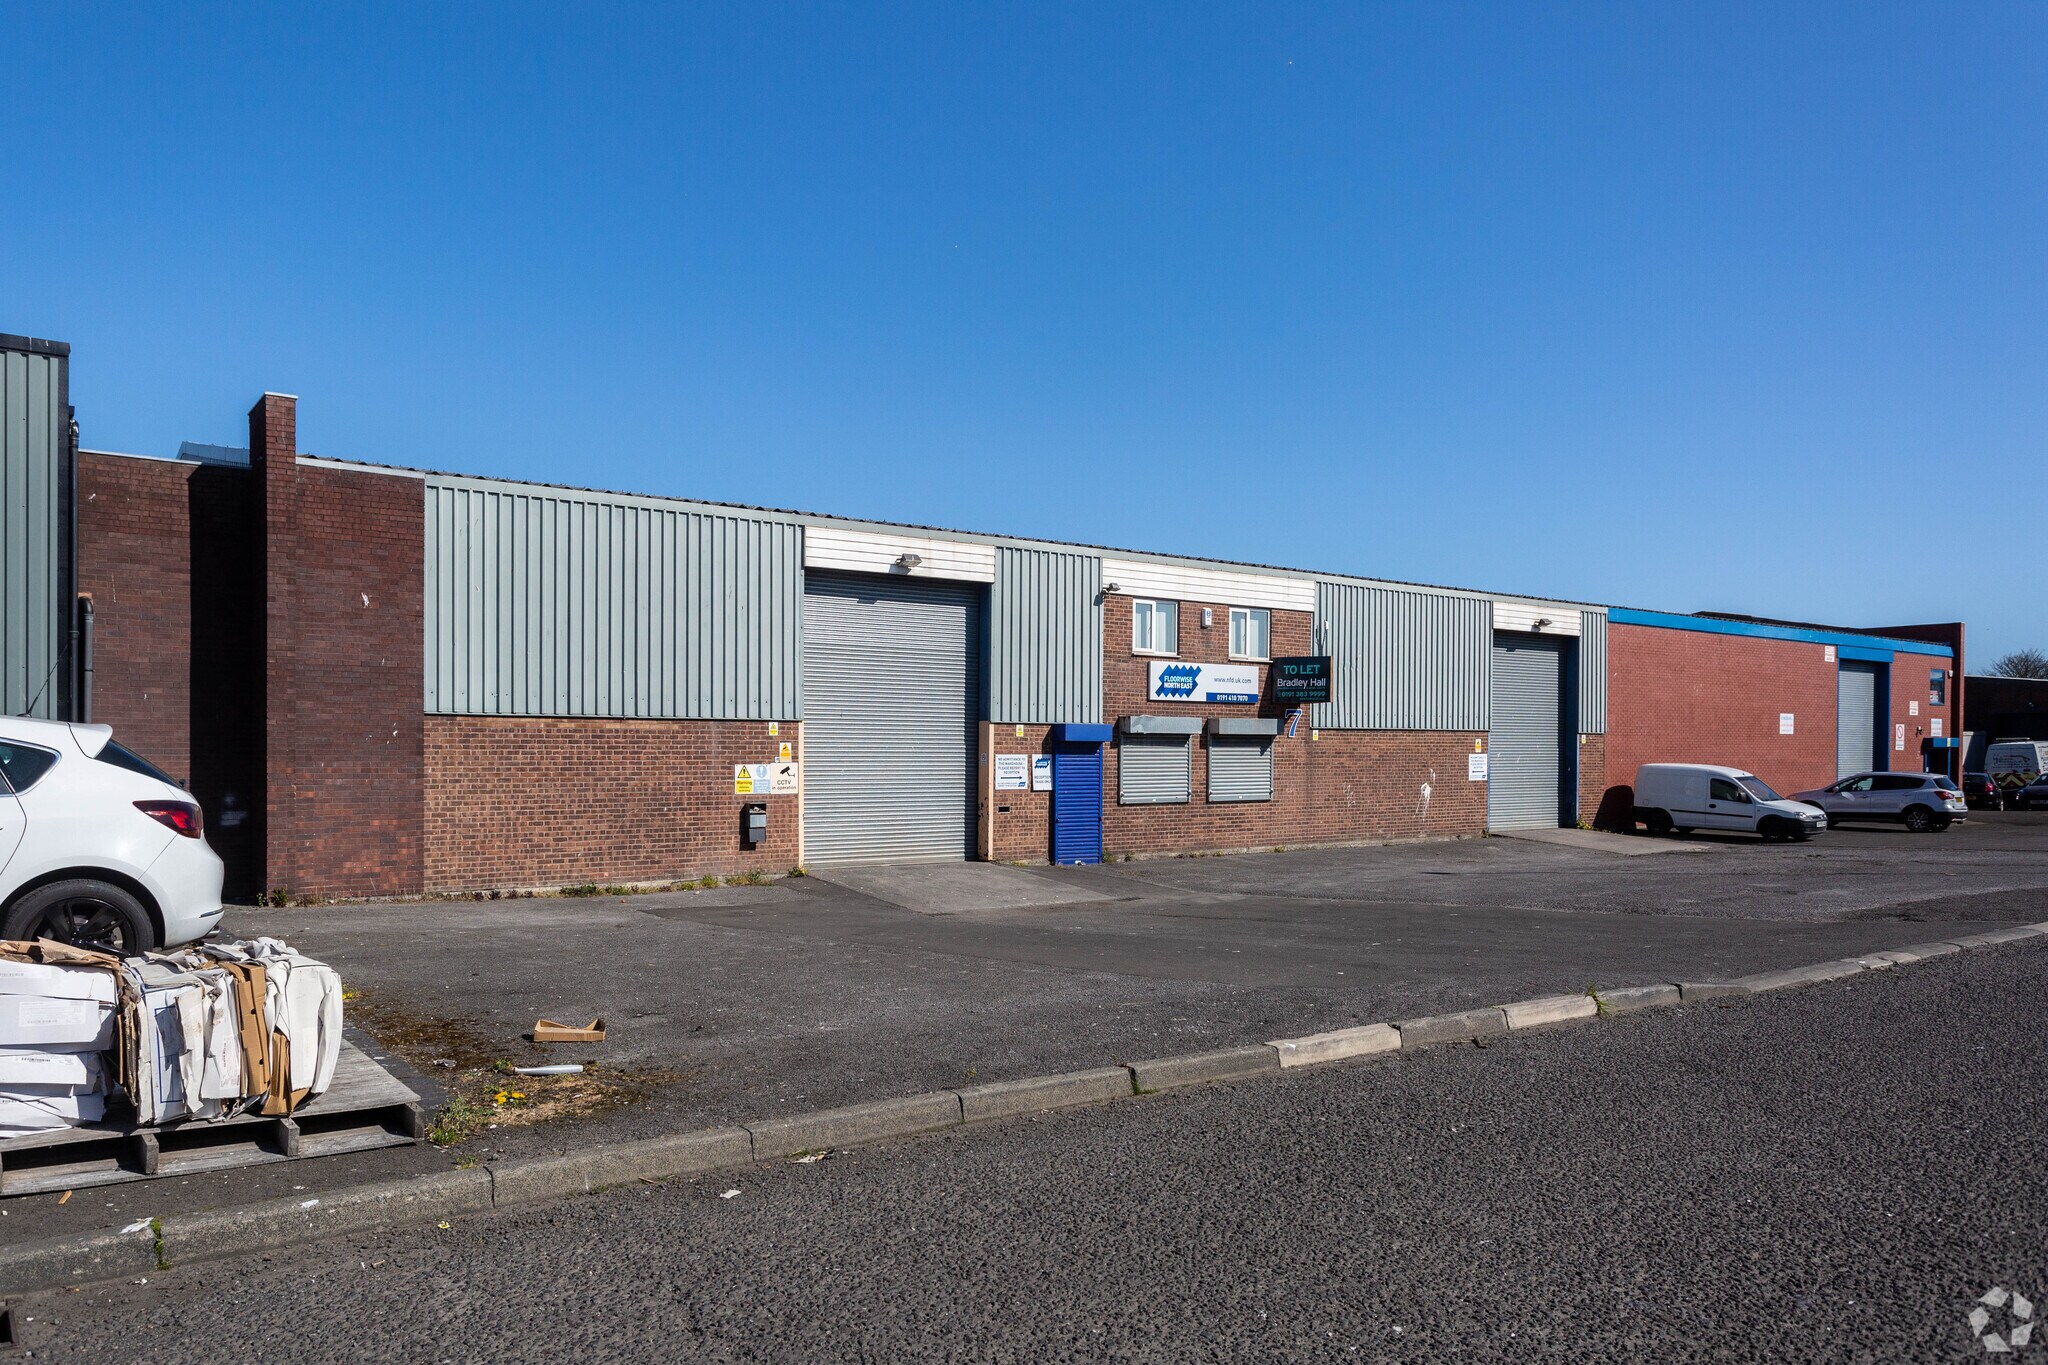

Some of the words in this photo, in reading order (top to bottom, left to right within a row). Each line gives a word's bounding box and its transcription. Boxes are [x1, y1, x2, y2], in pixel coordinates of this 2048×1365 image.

[1283, 665, 1298, 674] TO
[1300, 665, 1320, 674] LET
[1277, 678, 1308, 690] Bradley
[1310, 678, 1326, 687] Hall
[1285, 709, 1302, 738] 7
